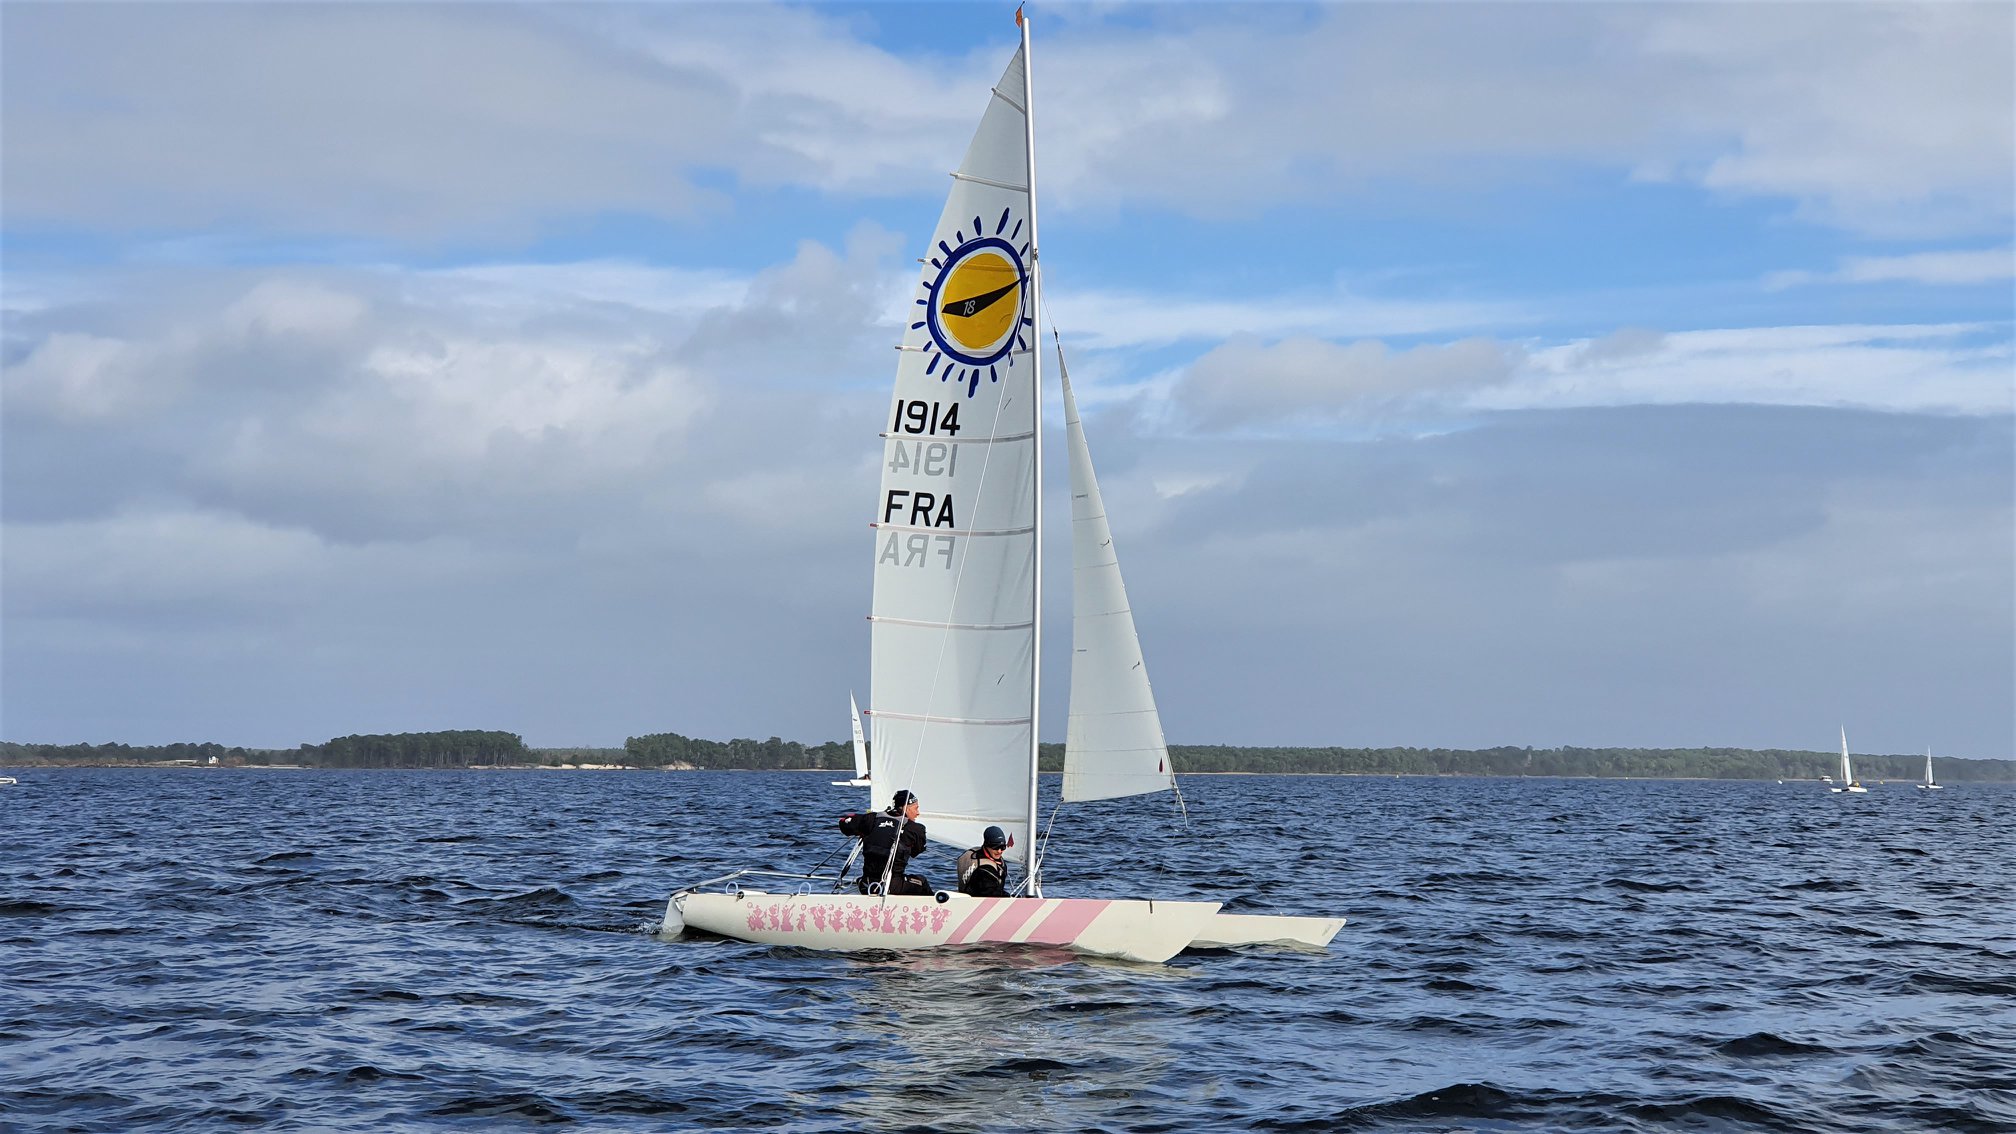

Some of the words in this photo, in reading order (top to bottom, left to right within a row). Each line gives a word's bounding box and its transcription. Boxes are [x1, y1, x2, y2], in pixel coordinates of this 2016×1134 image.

[962, 300, 976, 316] 18
[894, 399, 961, 436] 1914
[884, 490, 955, 528] FRA
